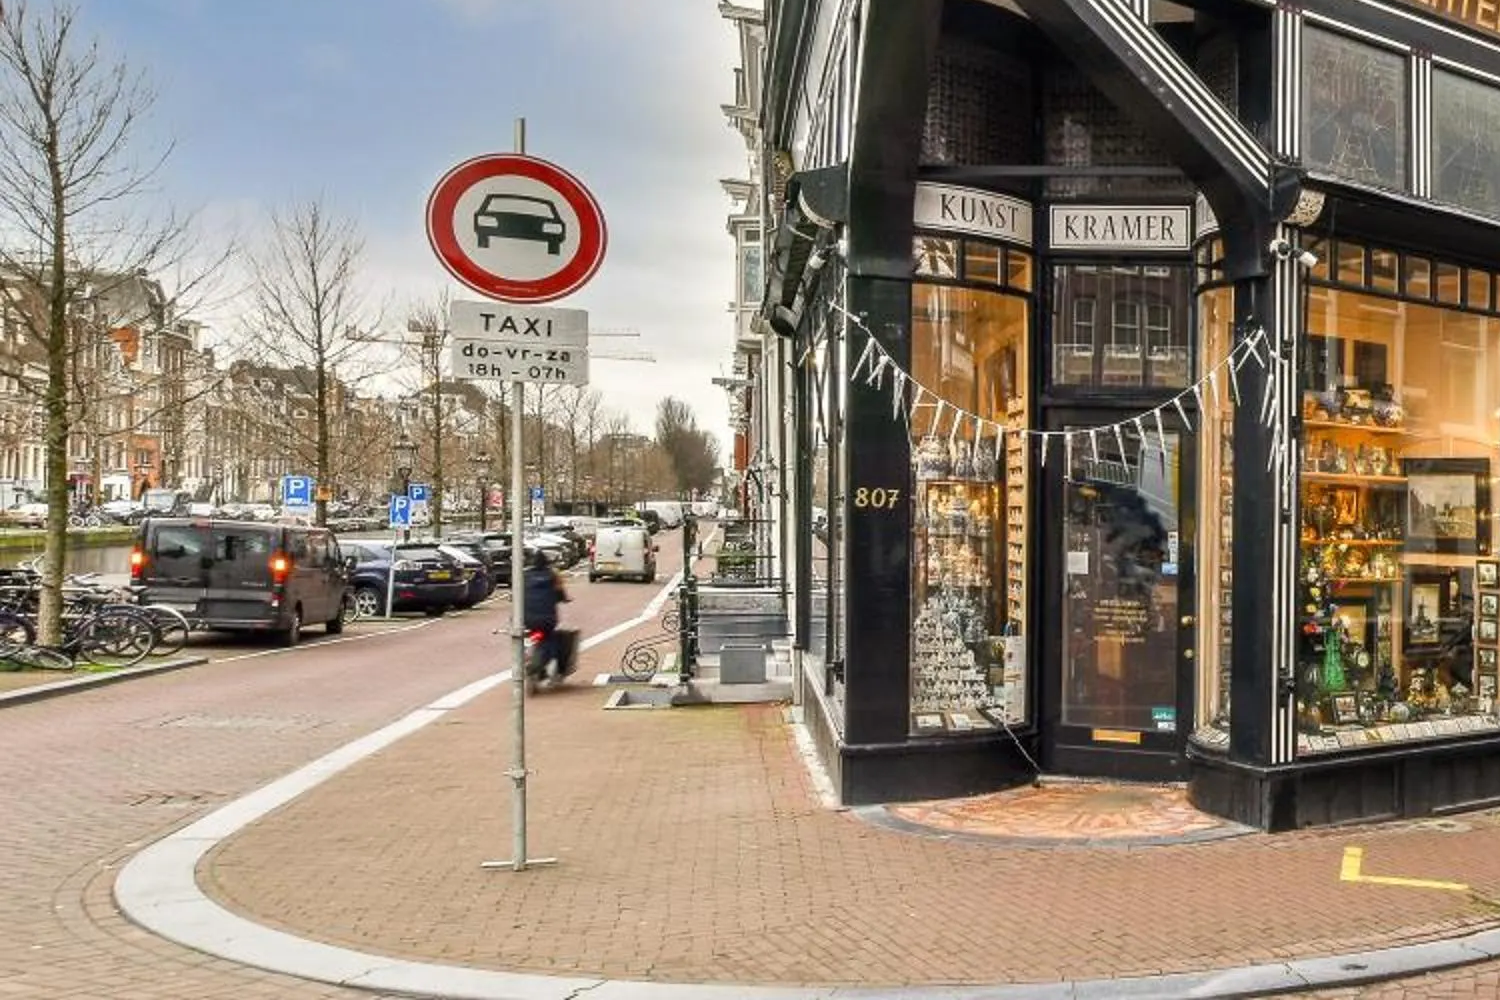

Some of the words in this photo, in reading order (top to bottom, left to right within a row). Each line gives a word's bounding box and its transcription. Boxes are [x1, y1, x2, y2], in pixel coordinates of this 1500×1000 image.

[940, 194, 1019, 234] KUNST
[1064, 214, 1175, 242] KRAMER
[480, 313, 552, 337] TAXI
[468, 363, 501, 377] 18h
[528, 365, 566, 379] 07h
[854, 487, 900, 509] 807
